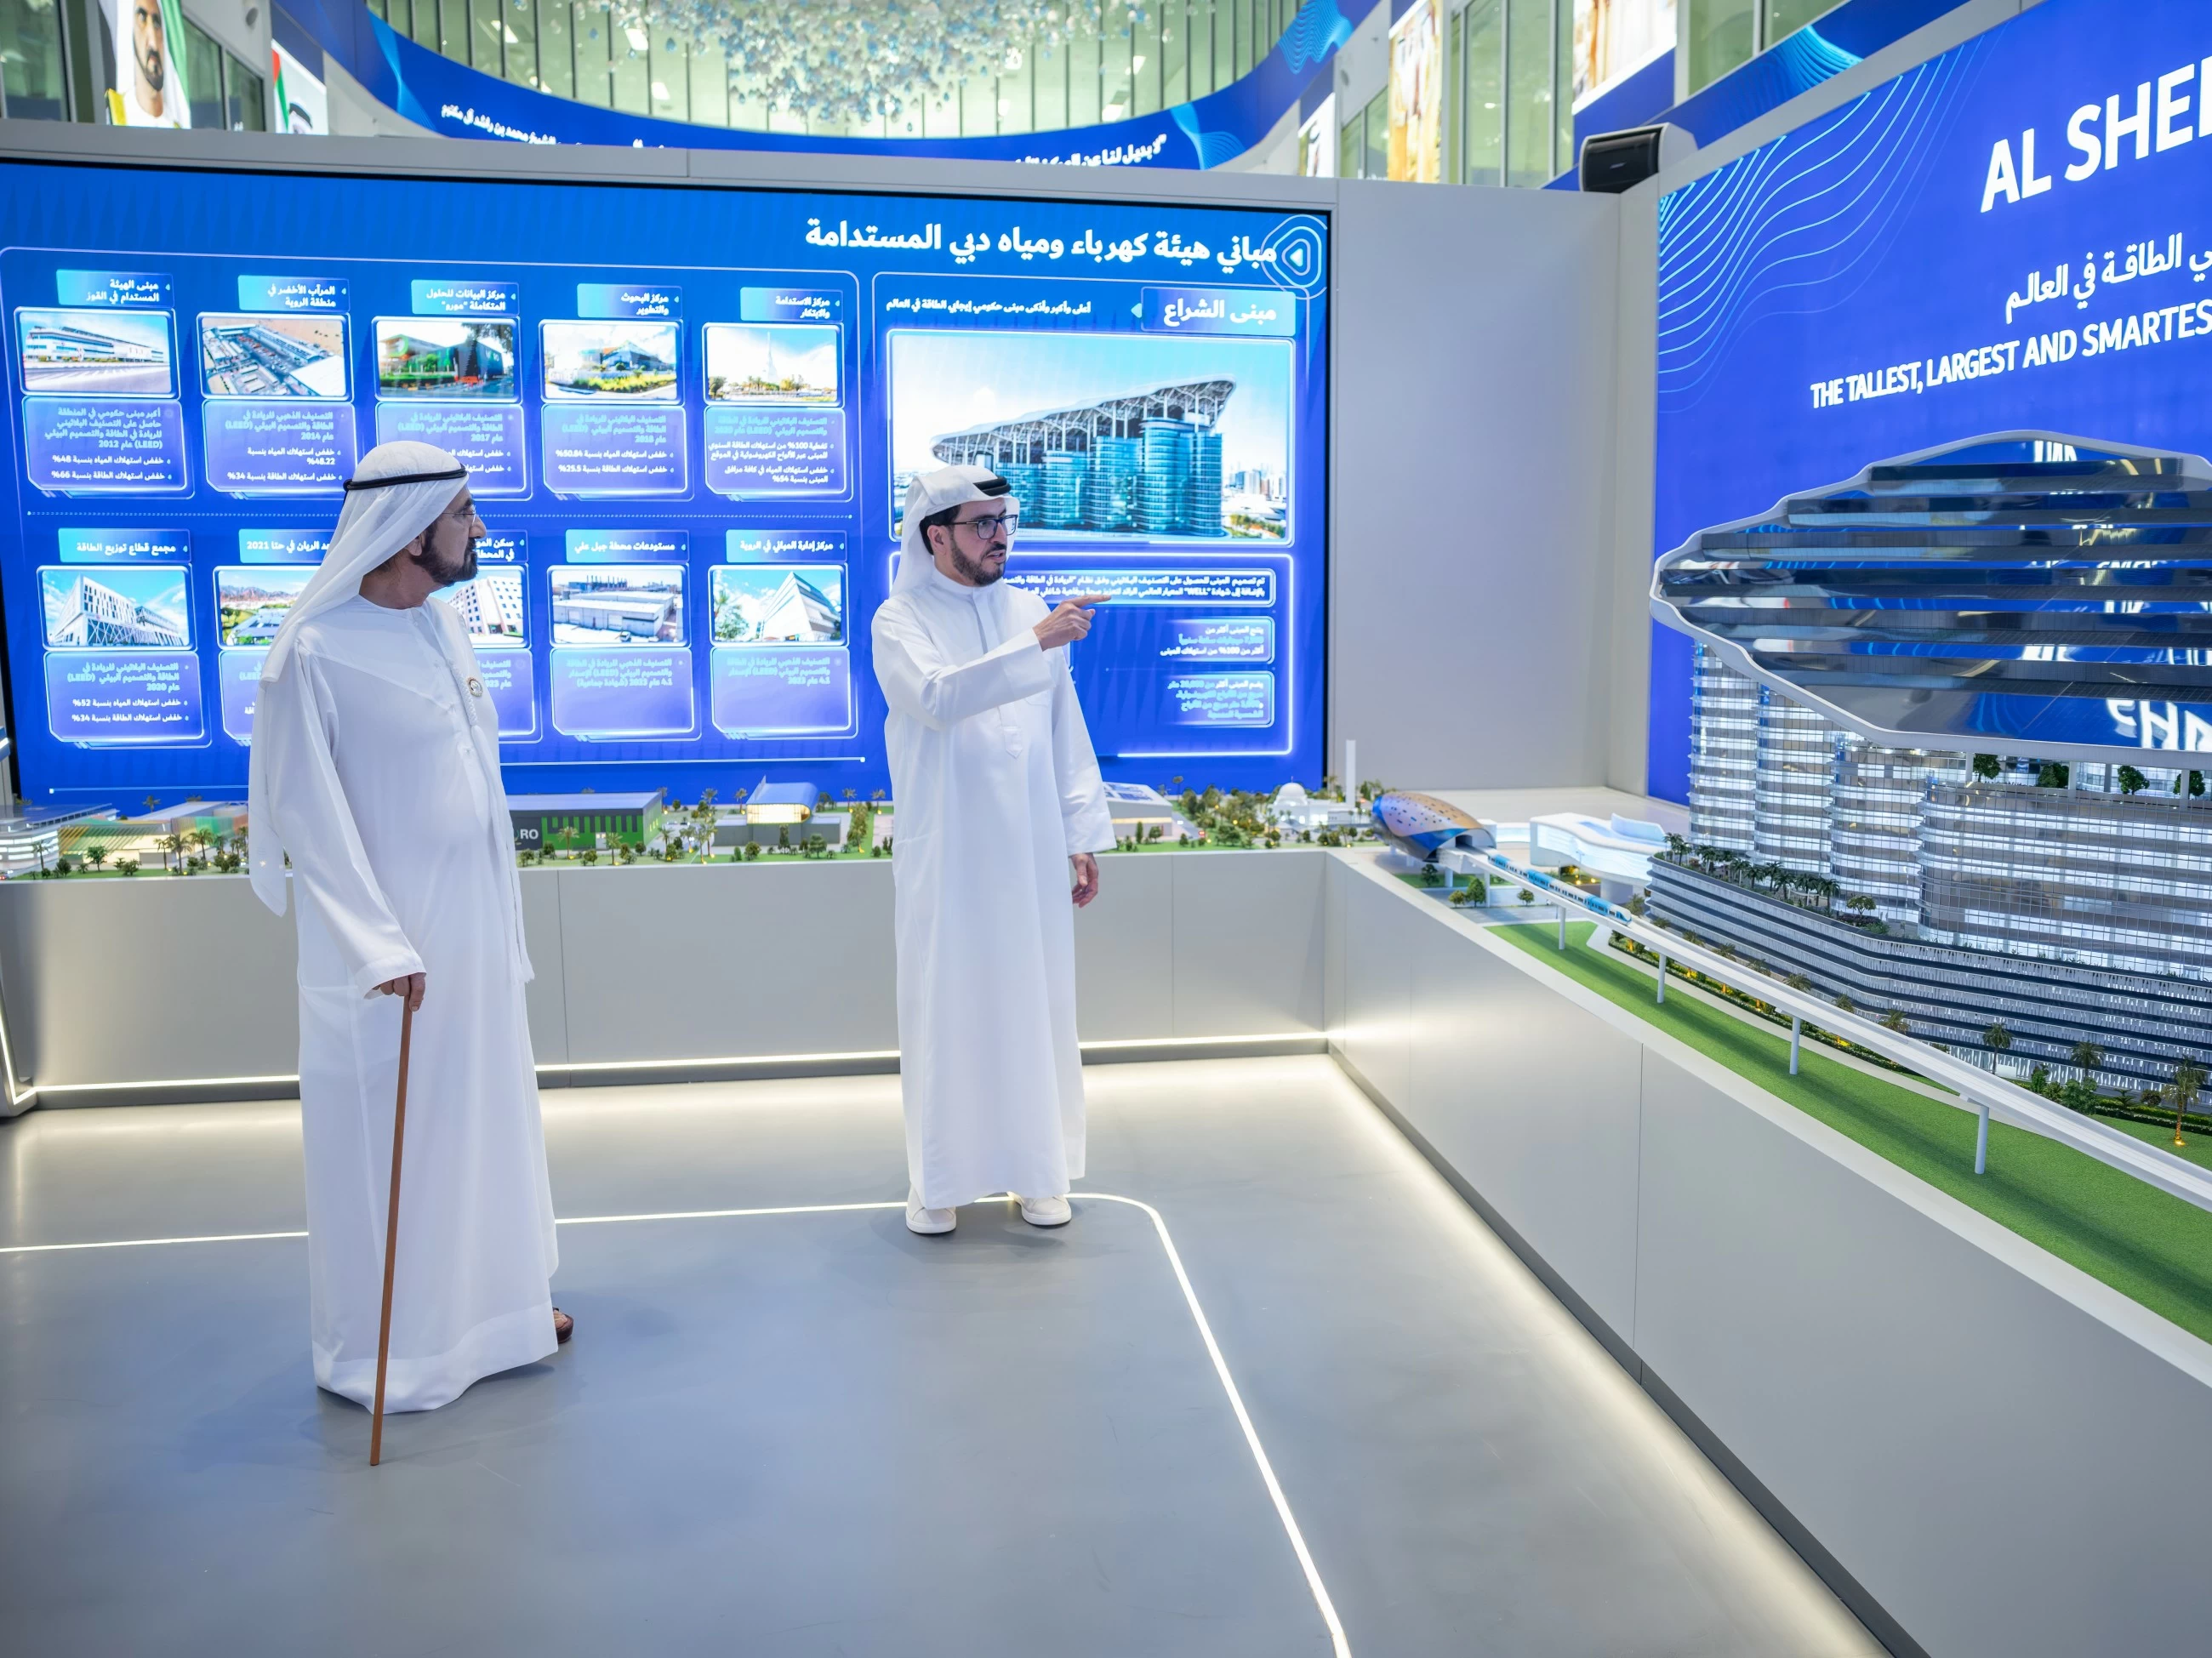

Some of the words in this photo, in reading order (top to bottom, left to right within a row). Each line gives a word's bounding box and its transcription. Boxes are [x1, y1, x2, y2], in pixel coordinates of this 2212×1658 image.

[1102, 146, 1121, 165] لنا
[1981, 128, 2051, 213] AL
[806, 218, 941, 249] المستدامة
[949, 233, 990, 265] دبي
[998, 226, 1064, 260] ومياه
[1071, 230, 1149, 263] كهرباء
[1154, 231, 1210, 265] هيئة
[1217, 236, 1276, 274] مباني
[2101, 232, 2182, 283] الطاقة
[110, 279, 134, 290] الهيئة
[137, 282, 158, 292] مبنى
[2073, 252, 2095, 310] في
[268, 283, 276, 297] في
[278, 284, 306, 295] الأخضر
[308, 284, 335, 296] المرآب
[426, 288, 453, 299] للحلول
[455, 289, 486, 300] البيانات
[487, 290, 505, 300] مركز
[2005, 264, 2068, 324] العالم
[87, 291, 107, 301] القوز
[109, 290, 118, 305] في
[121, 293, 159, 304] المستدام
[310, 297, 336, 307] منطقة
[621, 293, 650, 304] البحوث
[650, 293, 669, 303] مركز
[776, 296, 812, 305] الاستدامة
[812, 297, 830, 307] مركز
[470, 301, 505, 311] المتكاملة
[636, 305, 669, 316] والتطوير
[887, 299, 910, 311] العالم
[911, 298, 921, 312] في
[921, 299, 947, 310] الطاقة
[948, 301, 972, 313] إيجابي
[973, 301, 1002, 314] حكومي
[1004, 304, 1024, 313] مبنى
[1025, 300, 1050, 313] وأذكى
[1051, 301, 1071, 315] وأكبر
[1072, 301, 1091, 315] أعلى
[1164, 298, 1224, 327] الشراع
[1230, 303, 1276, 325] مبنى
[1810, 378, 1844, 408] THE
[1845, 362, 1924, 402] TALLEST,
[1926, 341, 2020, 387] LARGEST
[2023, 329, 2077, 367] AND
[77, 542, 102, 552] الطاقة
[105, 543, 127, 556] توزيع
[128, 543, 149, 556] قطاع
[151, 544, 176, 556] مجمع
[247, 541, 269, 550] 2021
[287, 539, 294, 553] في
[297, 540, 319, 551] الريان
[574, 541, 589, 554] علي
[591, 543, 607, 551] جبل
[609, 542, 631, 550] محطة
[633, 541, 675, 551] مستودعات
[517, 829, 539, 840] RO
